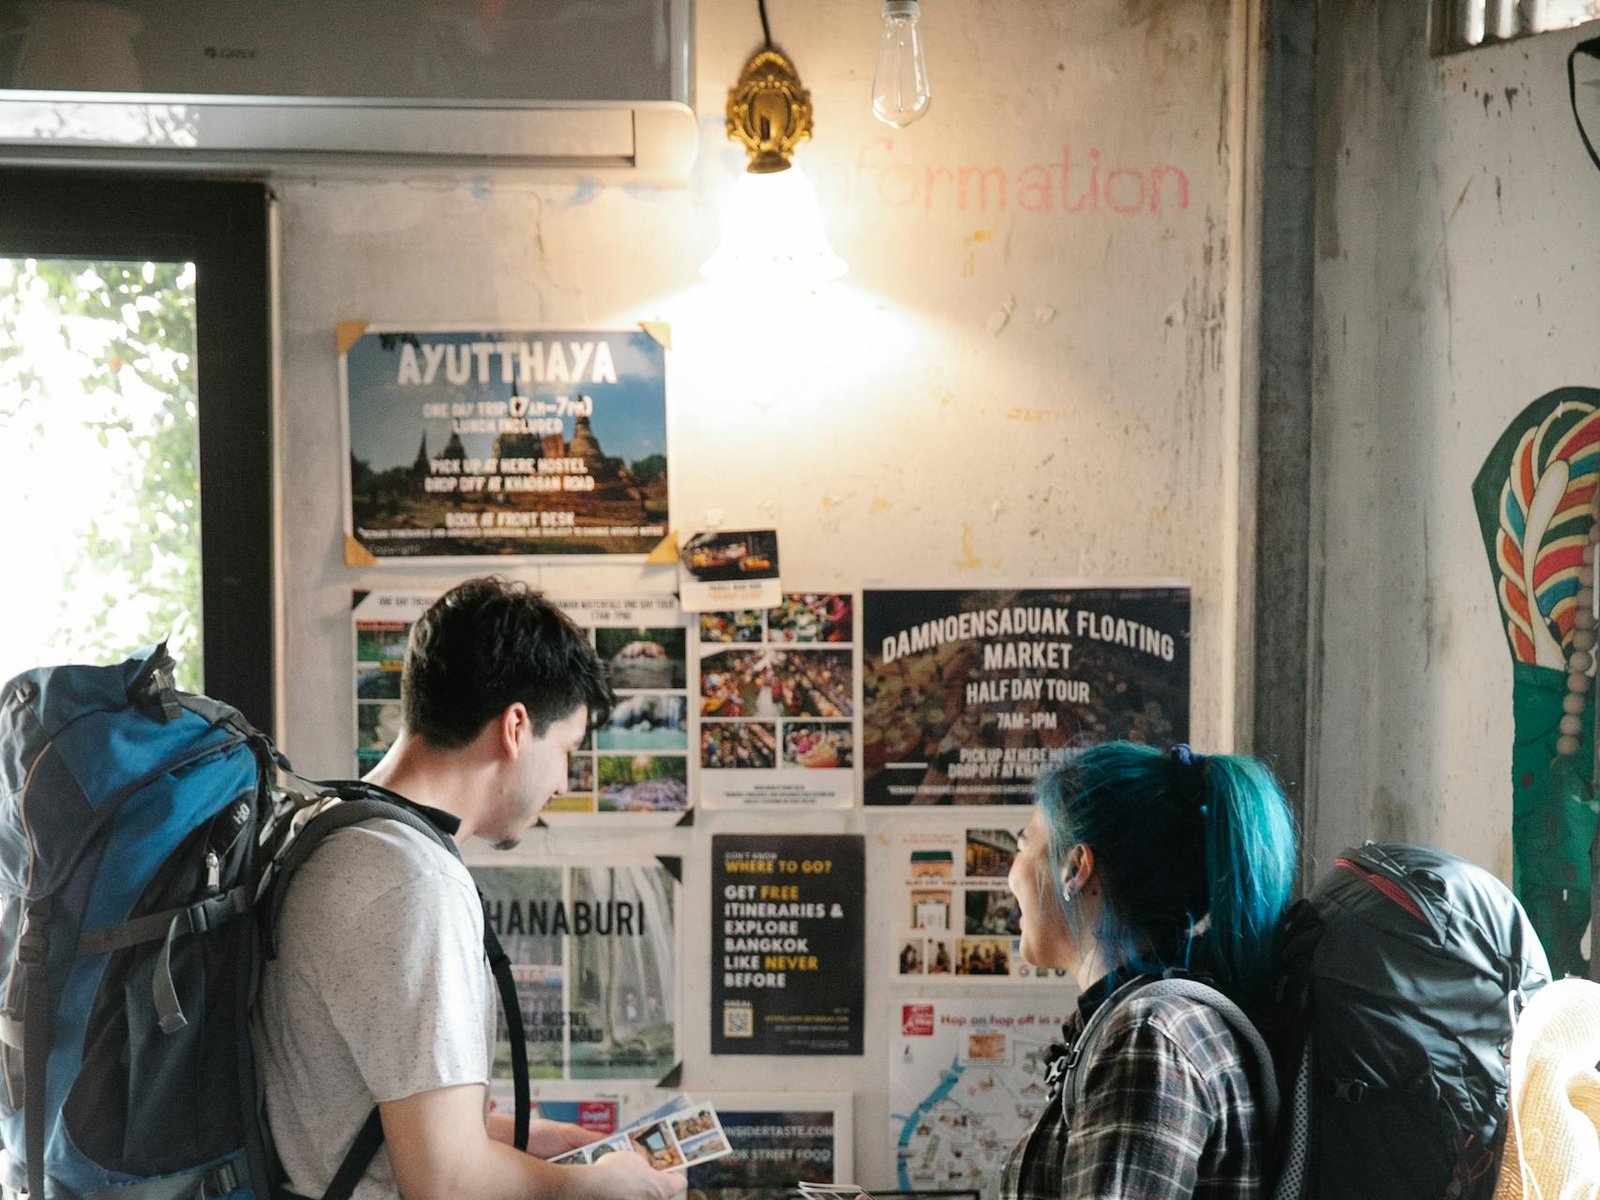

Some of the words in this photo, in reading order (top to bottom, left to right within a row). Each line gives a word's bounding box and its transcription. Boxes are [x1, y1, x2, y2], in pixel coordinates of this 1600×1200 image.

[855, 136, 1190, 214] formation
[397, 341, 617, 384] AYUTTHAYA
[430, 459, 460, 474] PICK
[424, 477, 458, 492] DROP
[540, 512, 575, 527] DESK
[882, 607, 1070, 665] DAMNOENSADUAK
[1077, 610, 1174, 662] FLOATING
[984, 642, 1072, 671] MARKET
[966, 680, 1009, 705] HALF
[1011, 680, 1043, 702] DAY
[1045, 681, 1091, 703] TOUR
[725, 860, 774, 873] WHERE
[778, 860, 798, 873] TO
[801, 860, 832, 873] GO?
[724, 885, 756, 900] GET
[760, 885, 799, 899] FREE
[724, 903, 825, 918] ITINERARIES
[830, 903, 843, 918] &
[487, 901, 645, 936] HANABURI
[724, 921, 798, 935] EXPLORE
[724, 938, 808, 952] BANGKOK
[724, 955, 760, 970] LIKE
[764, 955, 818, 970] NEVER
[724, 973, 786, 988] BEFORE
[941, 1016, 967, 1027] Hop
[989, 1015, 1014, 1028] hop
[1017, 1014, 1035, 1025] off
[751, 1149, 793, 1160] STREET
[795, 1149, 831, 1161] FOOD
